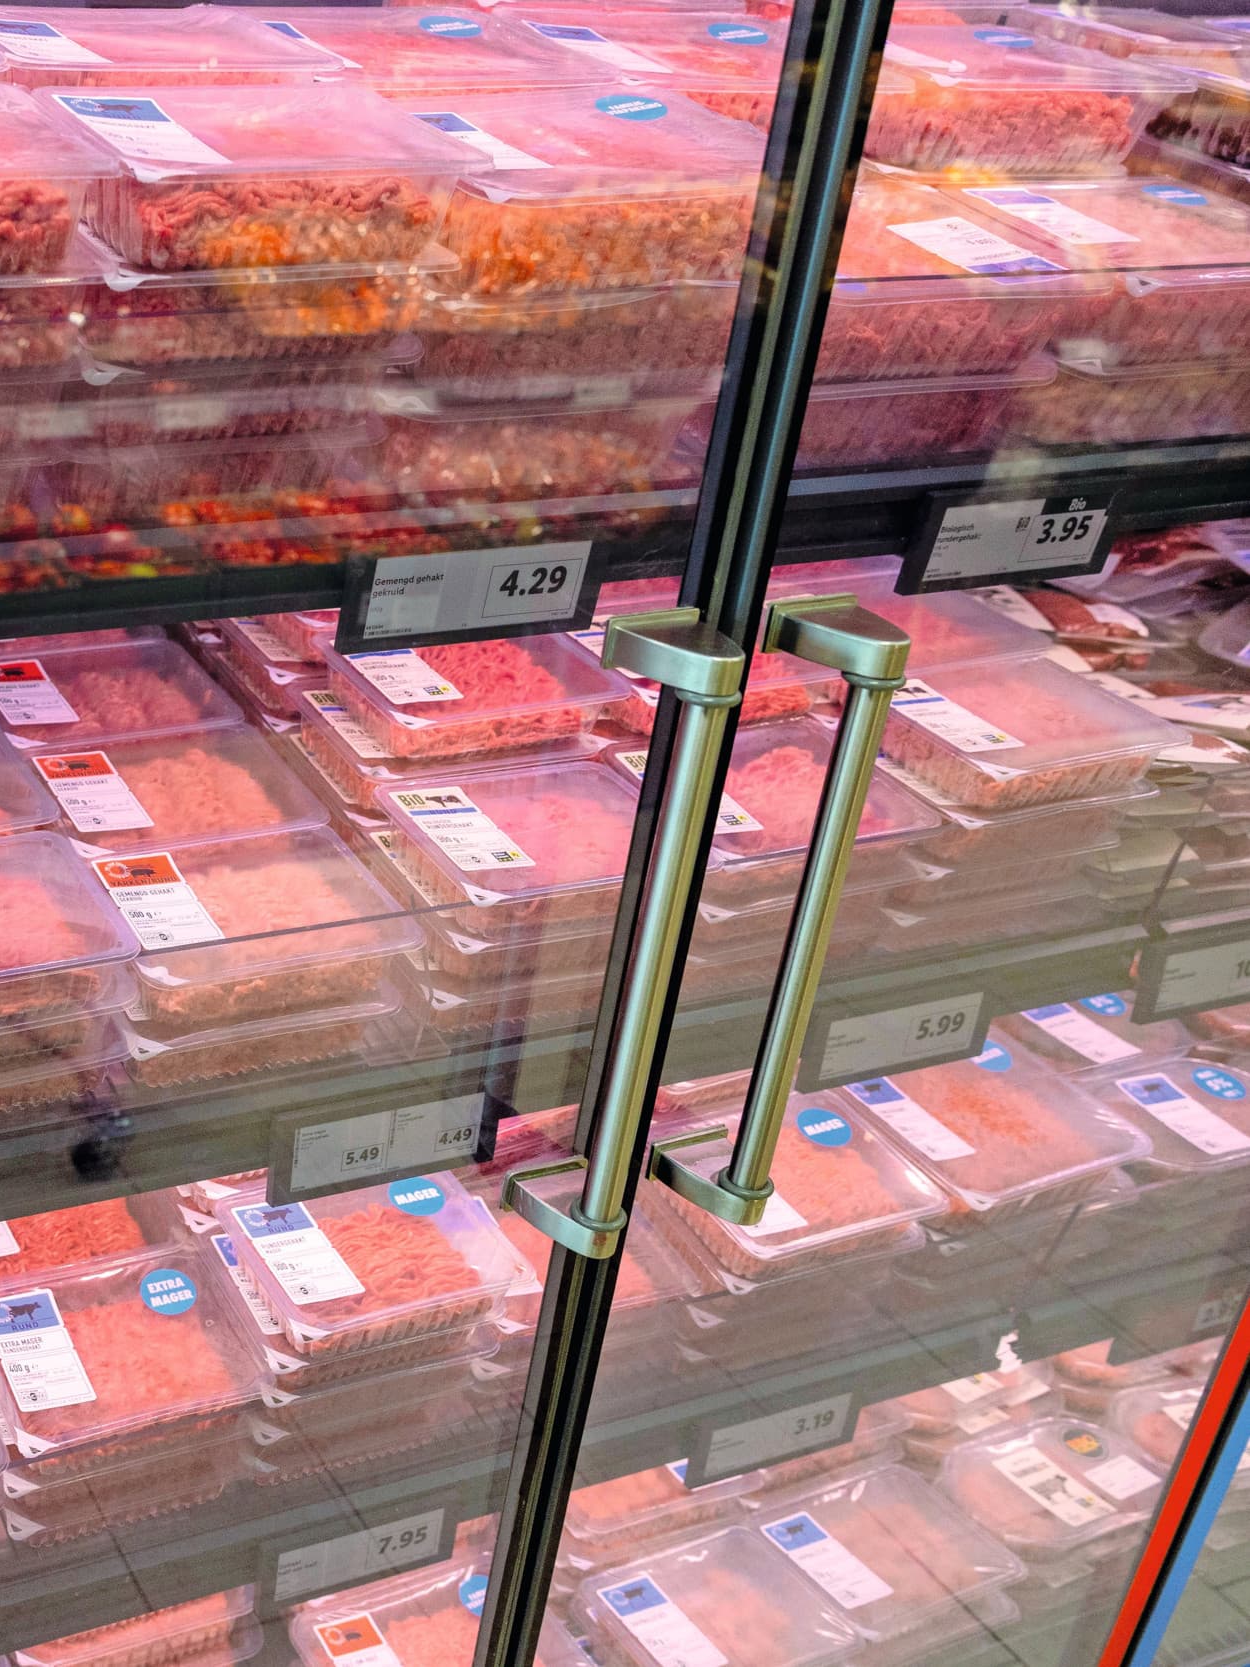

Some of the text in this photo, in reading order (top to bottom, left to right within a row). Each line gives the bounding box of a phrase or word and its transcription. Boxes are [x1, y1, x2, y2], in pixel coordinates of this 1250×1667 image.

[1068, 498, 1087, 511] Bio
[1036, 514, 1093, 545] 3.95
[374, 572, 445, 587] Gemengd gehakt
[499, 565, 568, 597] 4.29
[372, 586, 405, 599] gekruid
[915, 1011, 966, 1041] 5.99
[439, 1128, 472, 1145] 4.49
[345, 1147, 380, 1165] 5.49
[393, 1187, 441, 1206] MAGER
[146, 1277, 185, 1294] EXTRA
[150, 1289, 194, 1308] MAGER
[11, 1322, 39, 1331] RUND
[0, 1336, 43, 1349] EXTRA MAGER
[9, 1363, 31, 1373] 400 g
[794, 1409, 834, 1435] 3.19
[378, 1525, 428, 1555] 7.95
